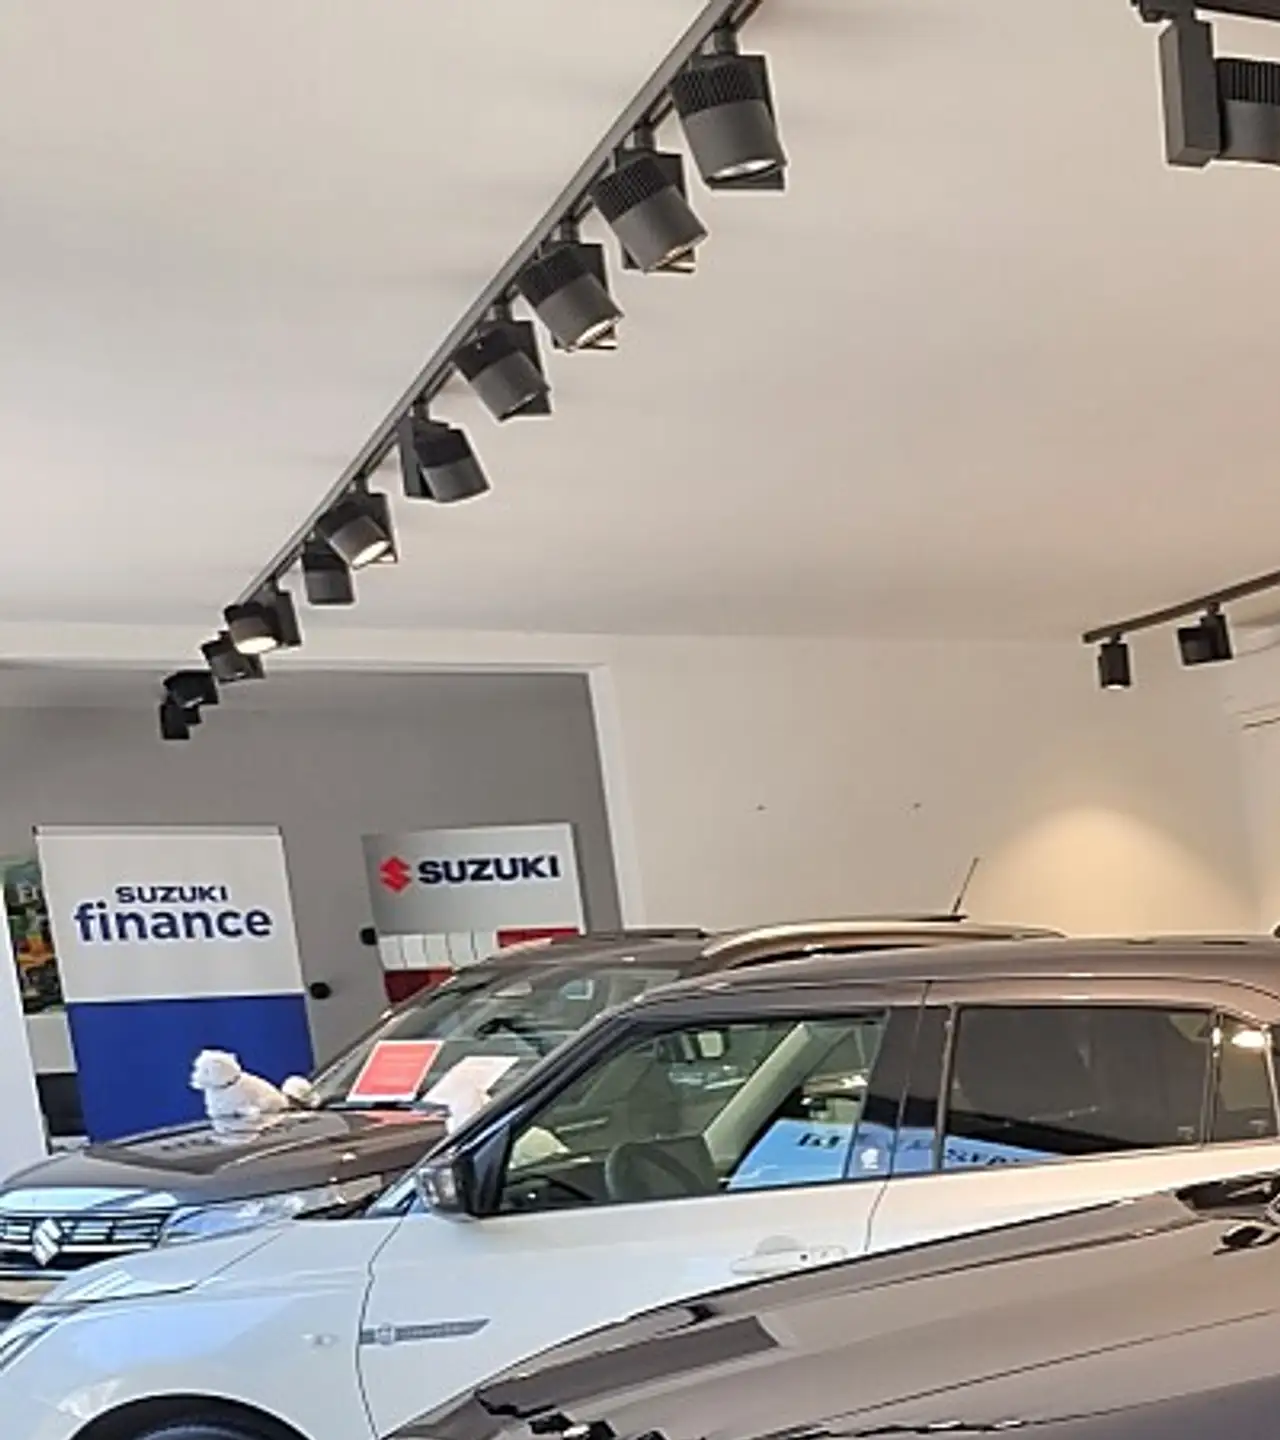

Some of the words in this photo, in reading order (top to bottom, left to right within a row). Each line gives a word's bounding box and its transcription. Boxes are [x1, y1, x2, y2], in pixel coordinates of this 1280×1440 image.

[418, 855, 561, 884] SUZUKI
[115, 886, 228, 903] SUZUKI
[74, 901, 273, 941] finance
